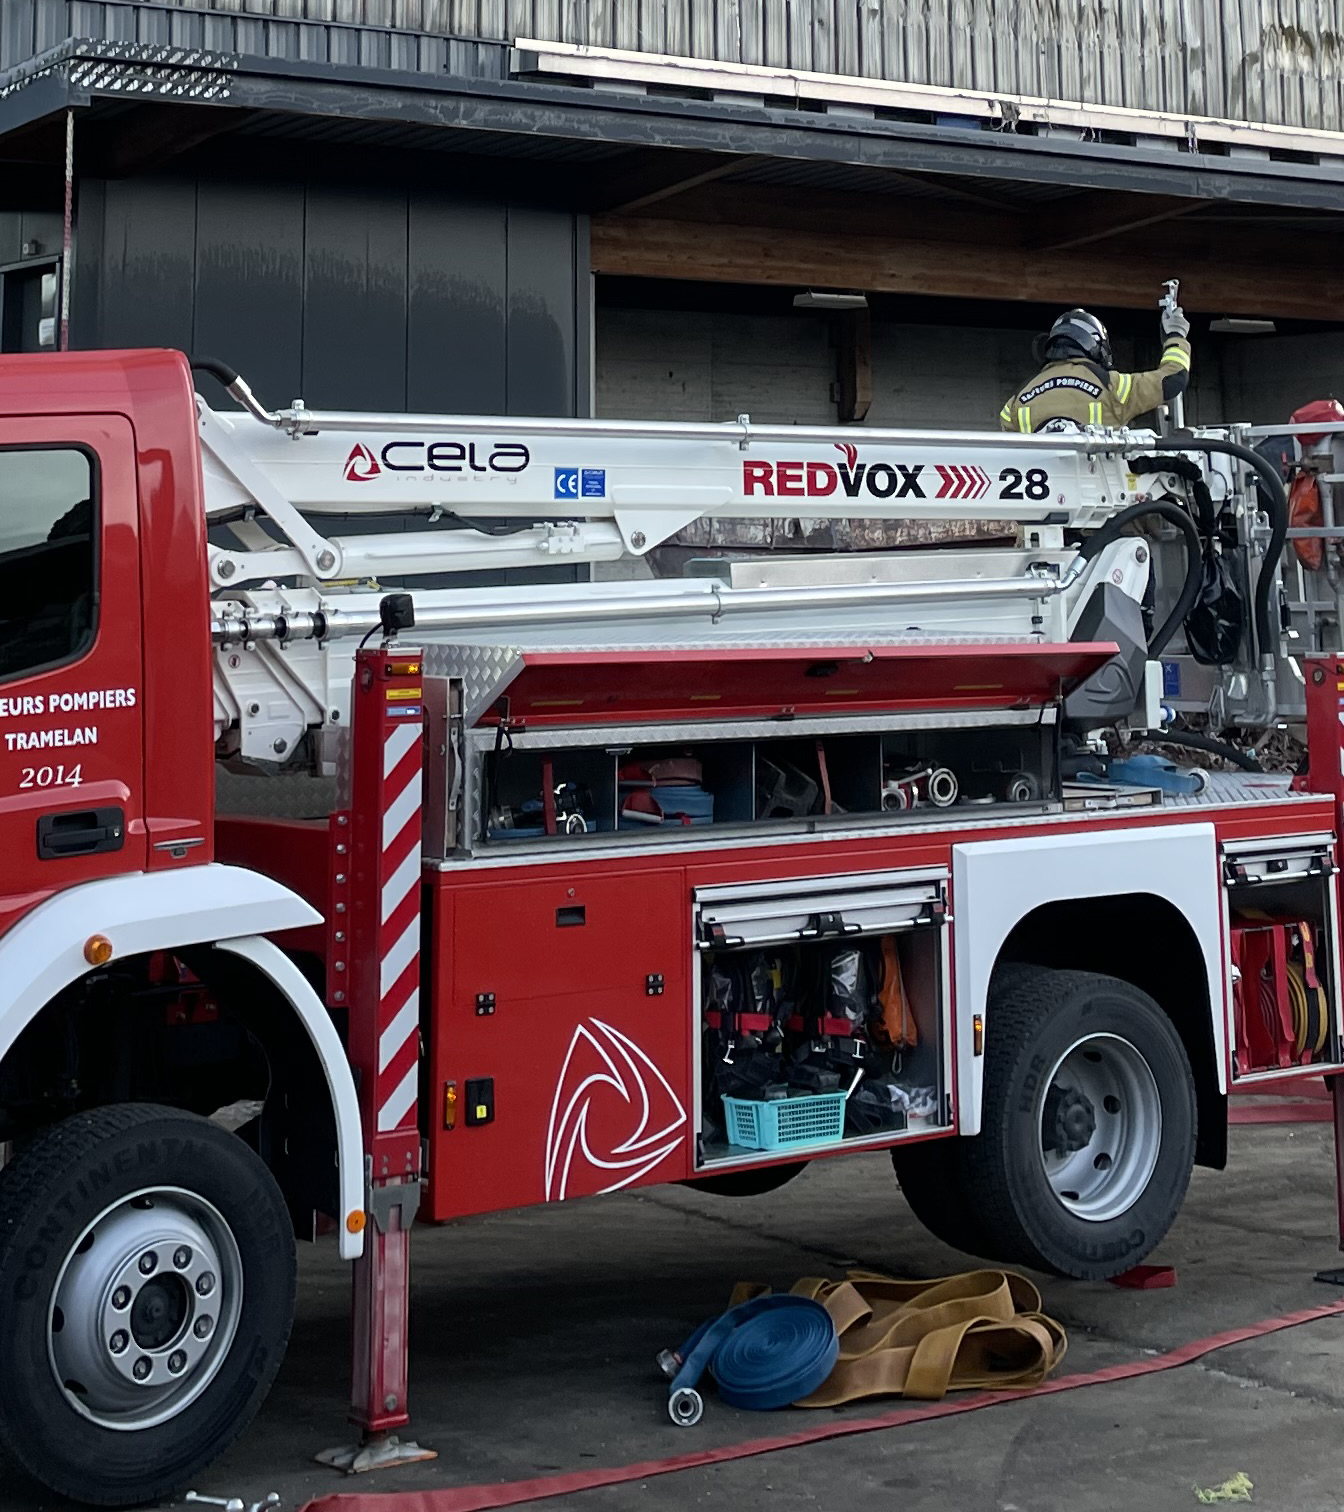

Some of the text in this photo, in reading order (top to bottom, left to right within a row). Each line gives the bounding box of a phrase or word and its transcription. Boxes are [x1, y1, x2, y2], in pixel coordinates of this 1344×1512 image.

[1056, 378, 1099, 396] POMPIERS
[396, 473, 518, 485] industry
[743, 459, 1050, 501] REDVOX 28
[49, 688, 136, 713] POMPIERS
[4, 726, 97, 751] TRAMELAN
[19, 763, 83, 788] 2014
